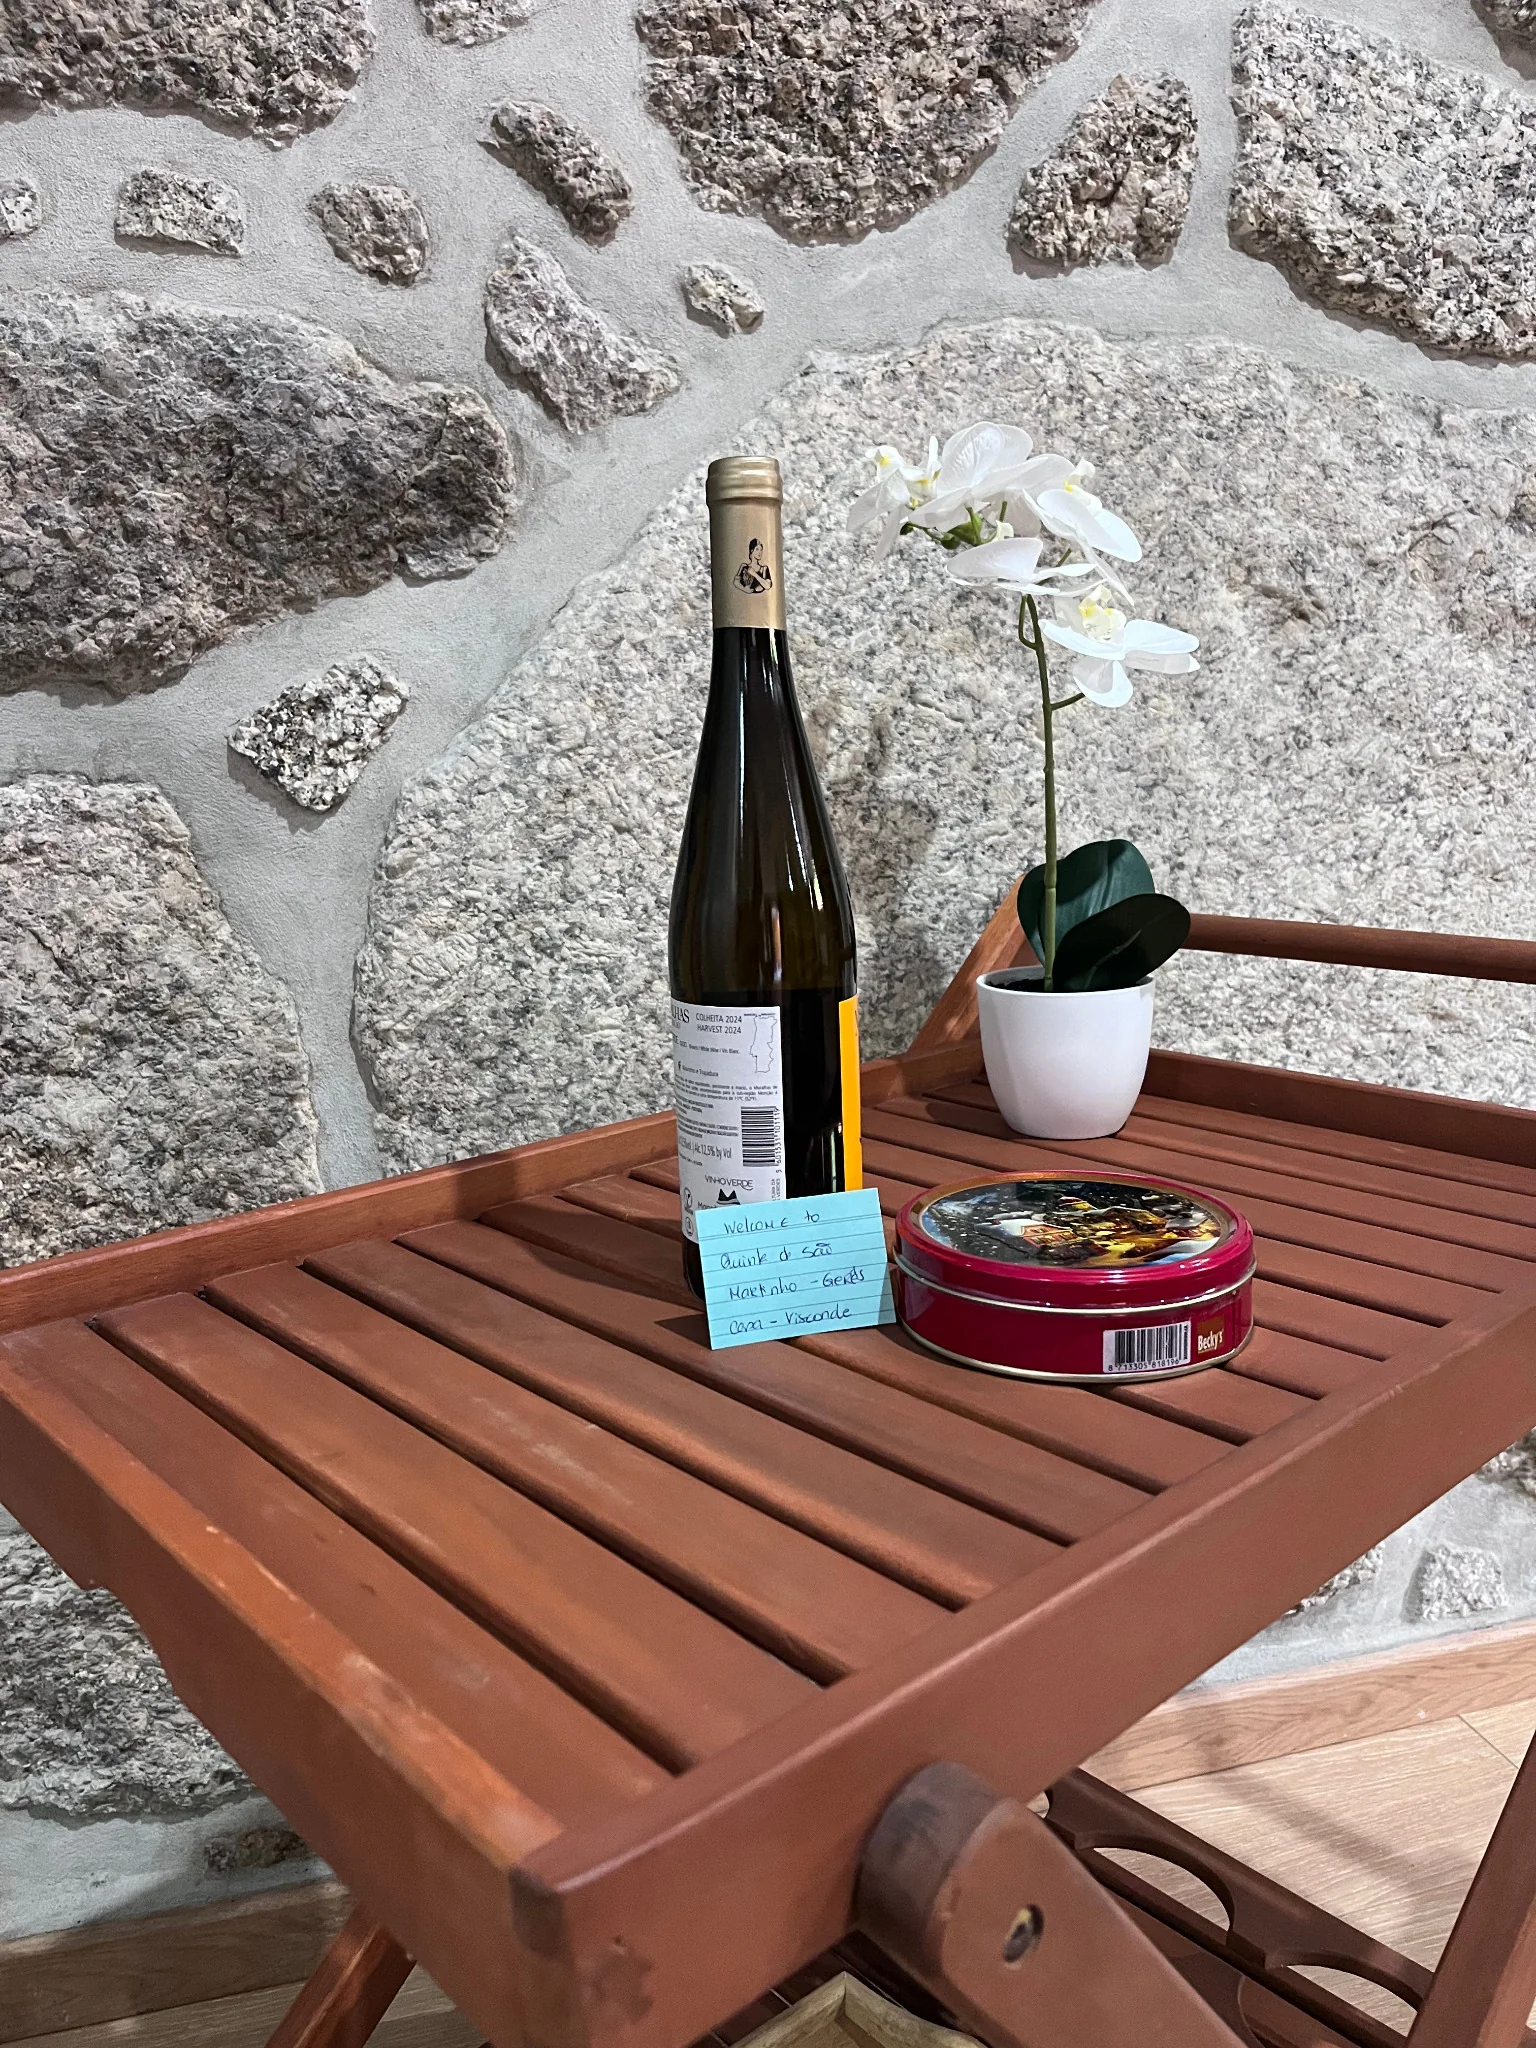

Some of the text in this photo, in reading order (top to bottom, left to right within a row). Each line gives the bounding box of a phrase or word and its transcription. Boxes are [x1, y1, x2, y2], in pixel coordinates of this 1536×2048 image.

[696, 1013, 724, 1023] COLHEITA
[725, 1015, 742, 1023] 2024
[697, 1025, 742, 1034] HARVEST 2024
[775, 1137, 783, 1164] 601531
[724, 1210, 820, 1235] Welcome to
[729, 1278, 797, 1301] Martinho
[785, 1303, 852, 1326] Visconde
[1197, 1329, 1224, 1351] Becky's
[1107, 1364, 1113, 1372] 8
